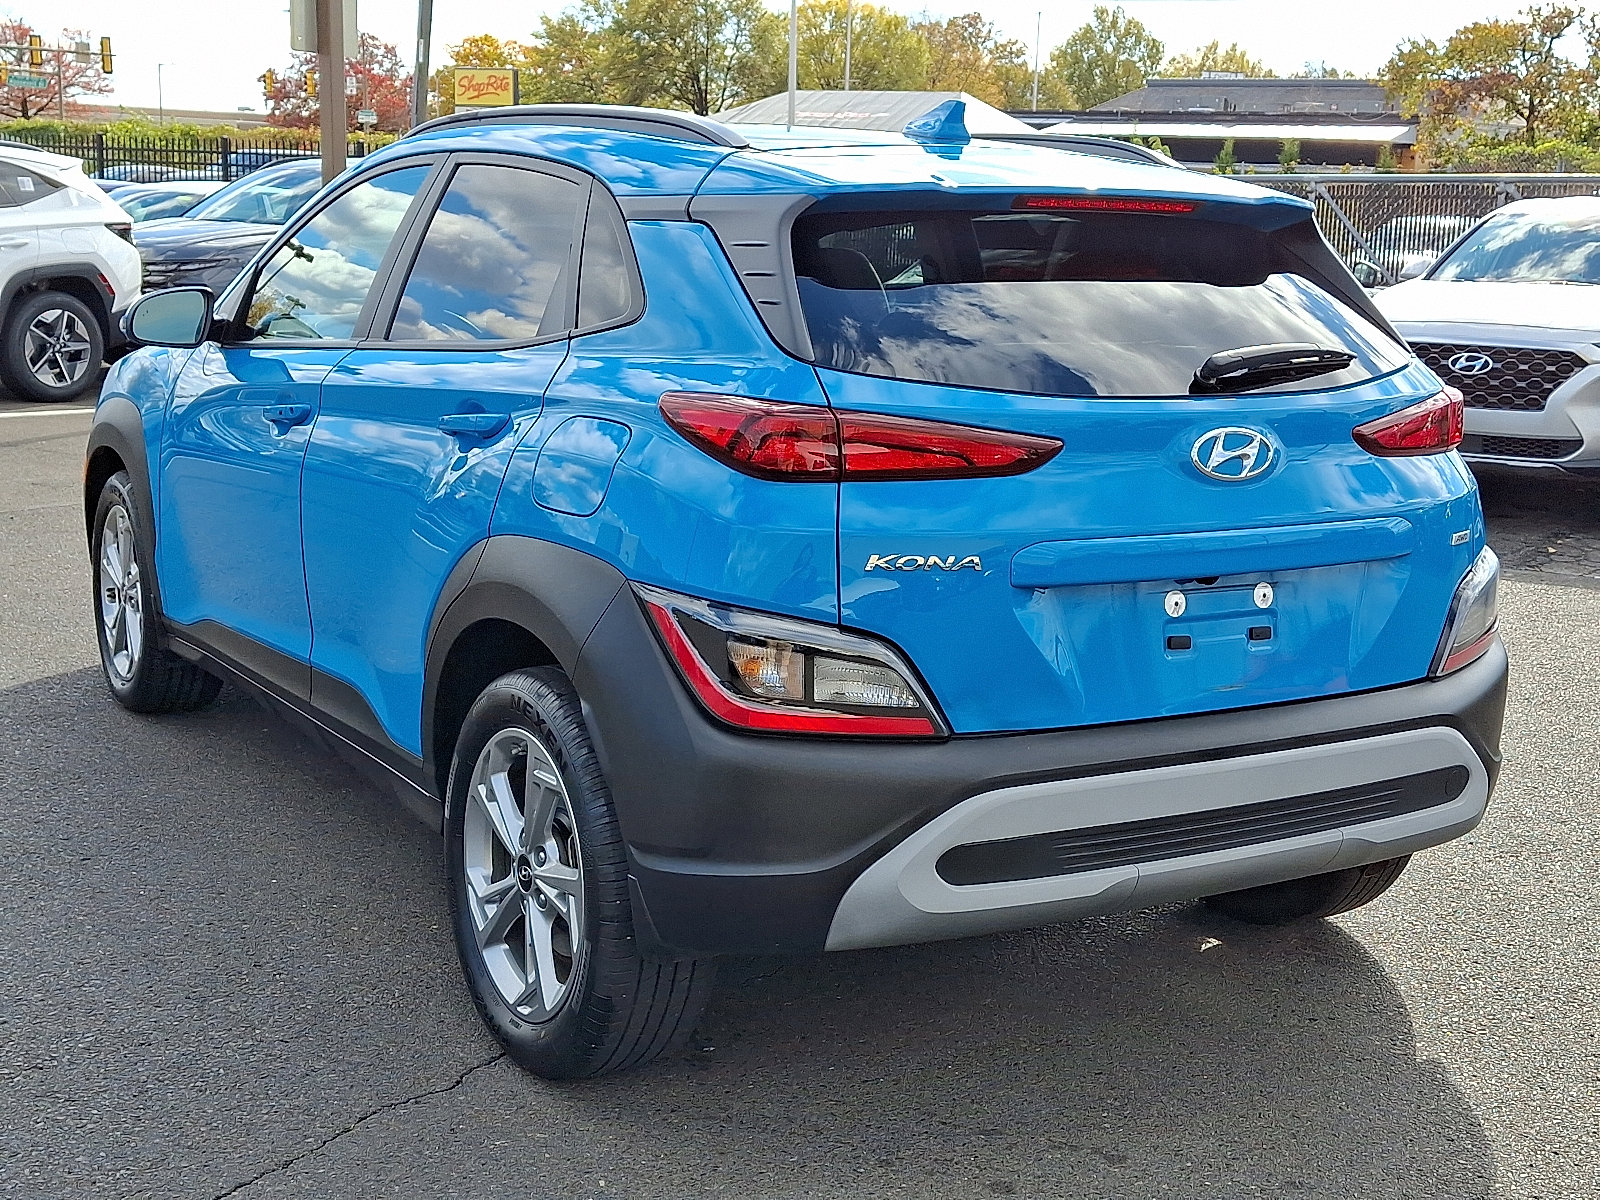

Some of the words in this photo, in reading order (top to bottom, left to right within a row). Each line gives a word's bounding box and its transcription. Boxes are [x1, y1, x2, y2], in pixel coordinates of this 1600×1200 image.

[457, 74, 510, 100] ShopRite
[864, 553, 983, 571] KONA
[510, 693, 569, 777] NEXEN
